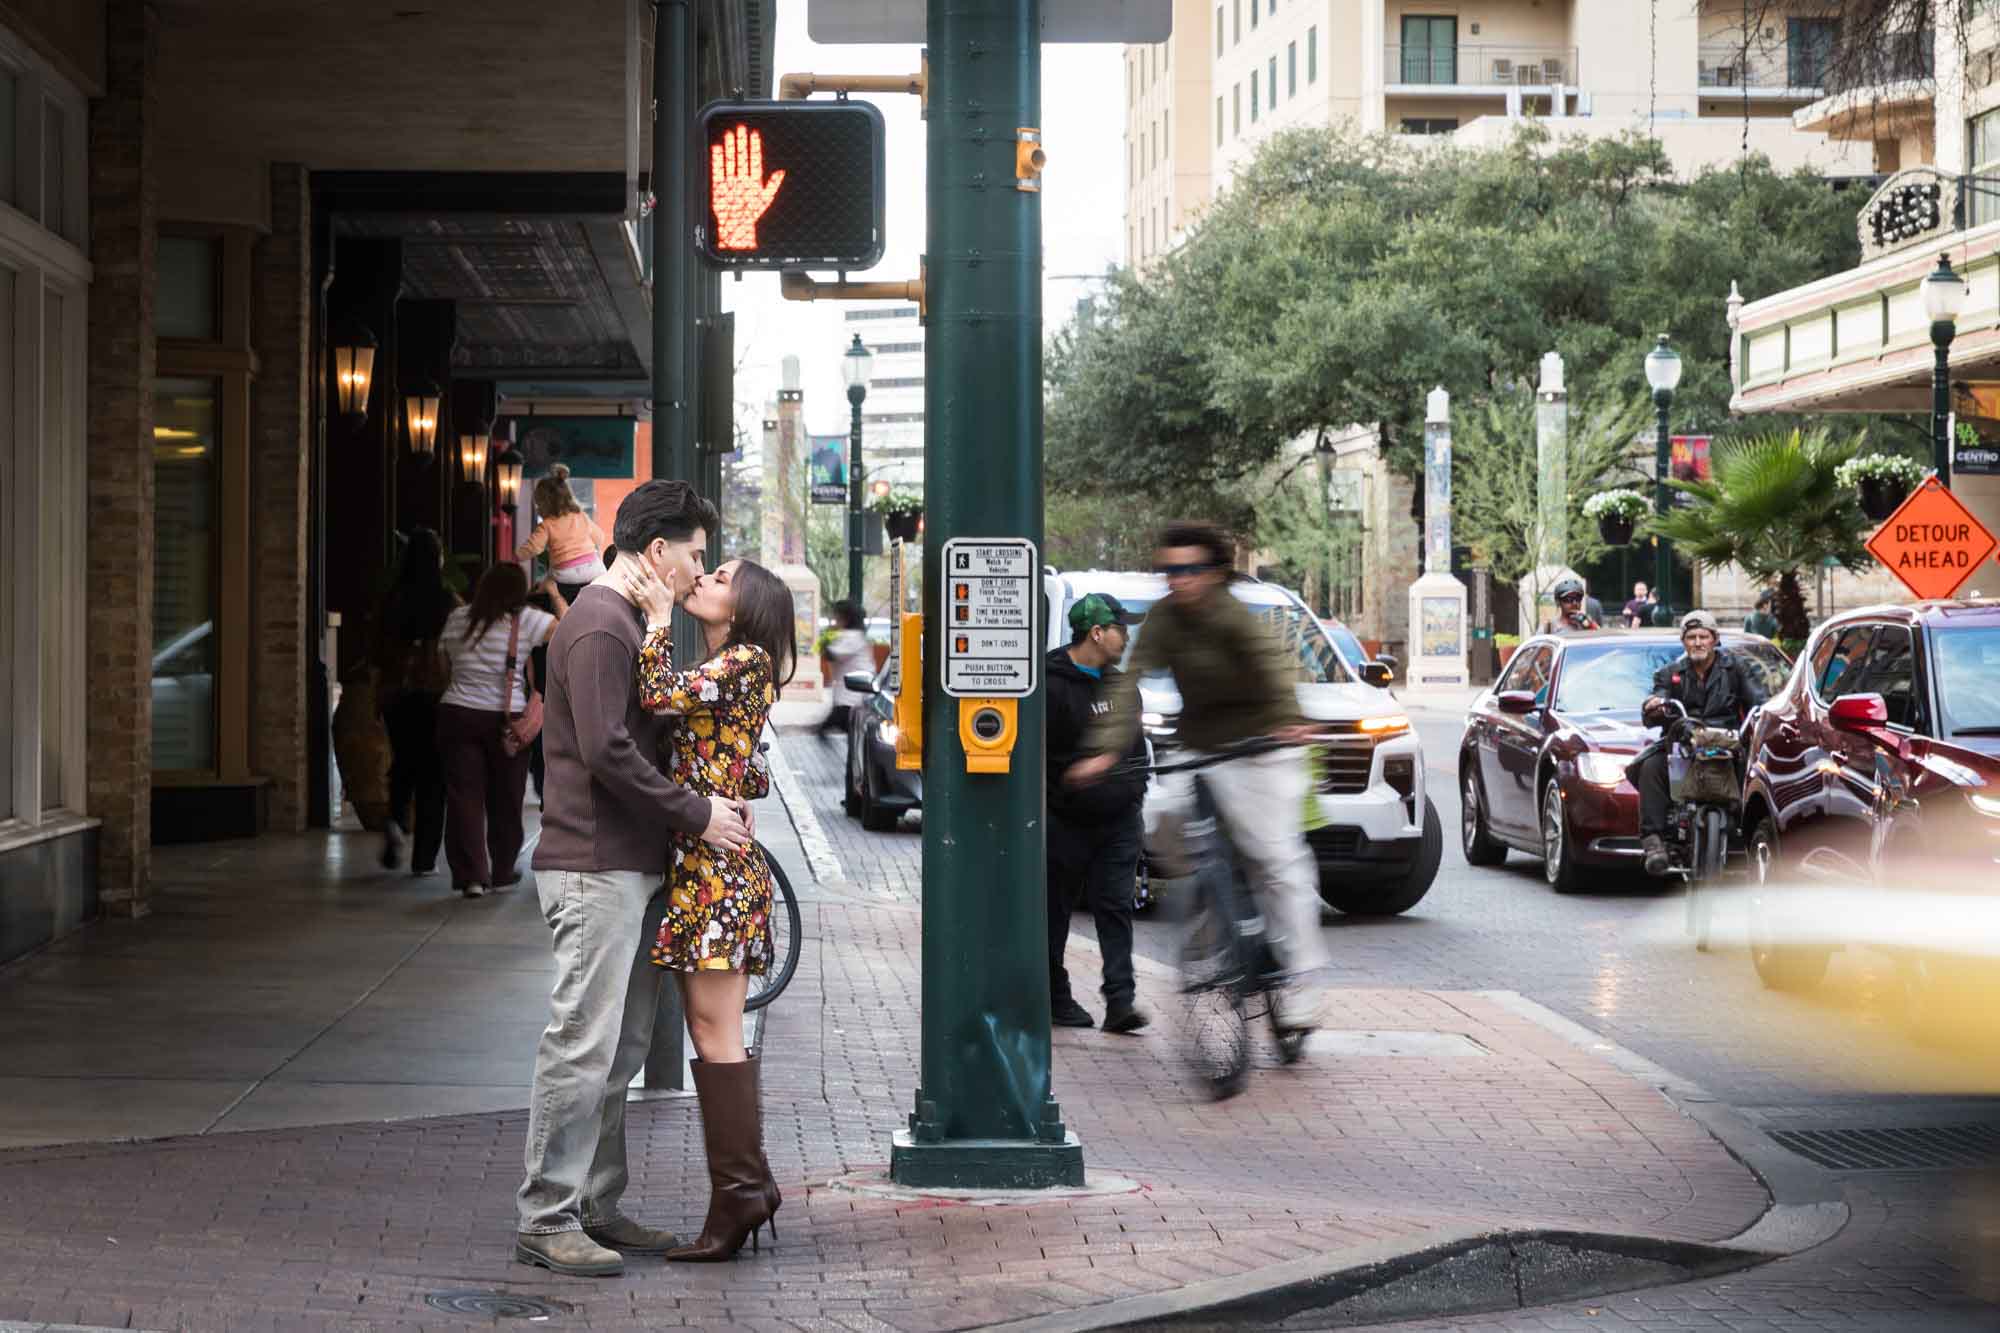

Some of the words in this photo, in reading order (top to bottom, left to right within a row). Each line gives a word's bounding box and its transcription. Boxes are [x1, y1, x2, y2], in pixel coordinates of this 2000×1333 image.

[1956, 452, 1999, 463] CENTRO
[814, 487, 845, 496] CENTRO
[1896, 524, 1970, 543] DETOUR
[976, 548, 993, 557] START
[995, 548, 1023, 557] CROSSING
[986, 558, 1001, 566] Watch
[1898, 551, 1969, 569] AHEAD
[979, 588, 995, 596] Finish
[997, 588, 1020, 598] Crossing
[976, 607, 988, 616] TIME
[991, 607, 1022, 616] REMAINING
[1002, 617, 1023, 626] Crossing
[1000, 639, 1018, 648] CROSS
[965, 663, 984, 672] PUSH
[986, 663, 1013, 672] BUTTON
[971, 677, 981, 686] TO
[983, 677, 1007, 686] CROSS
